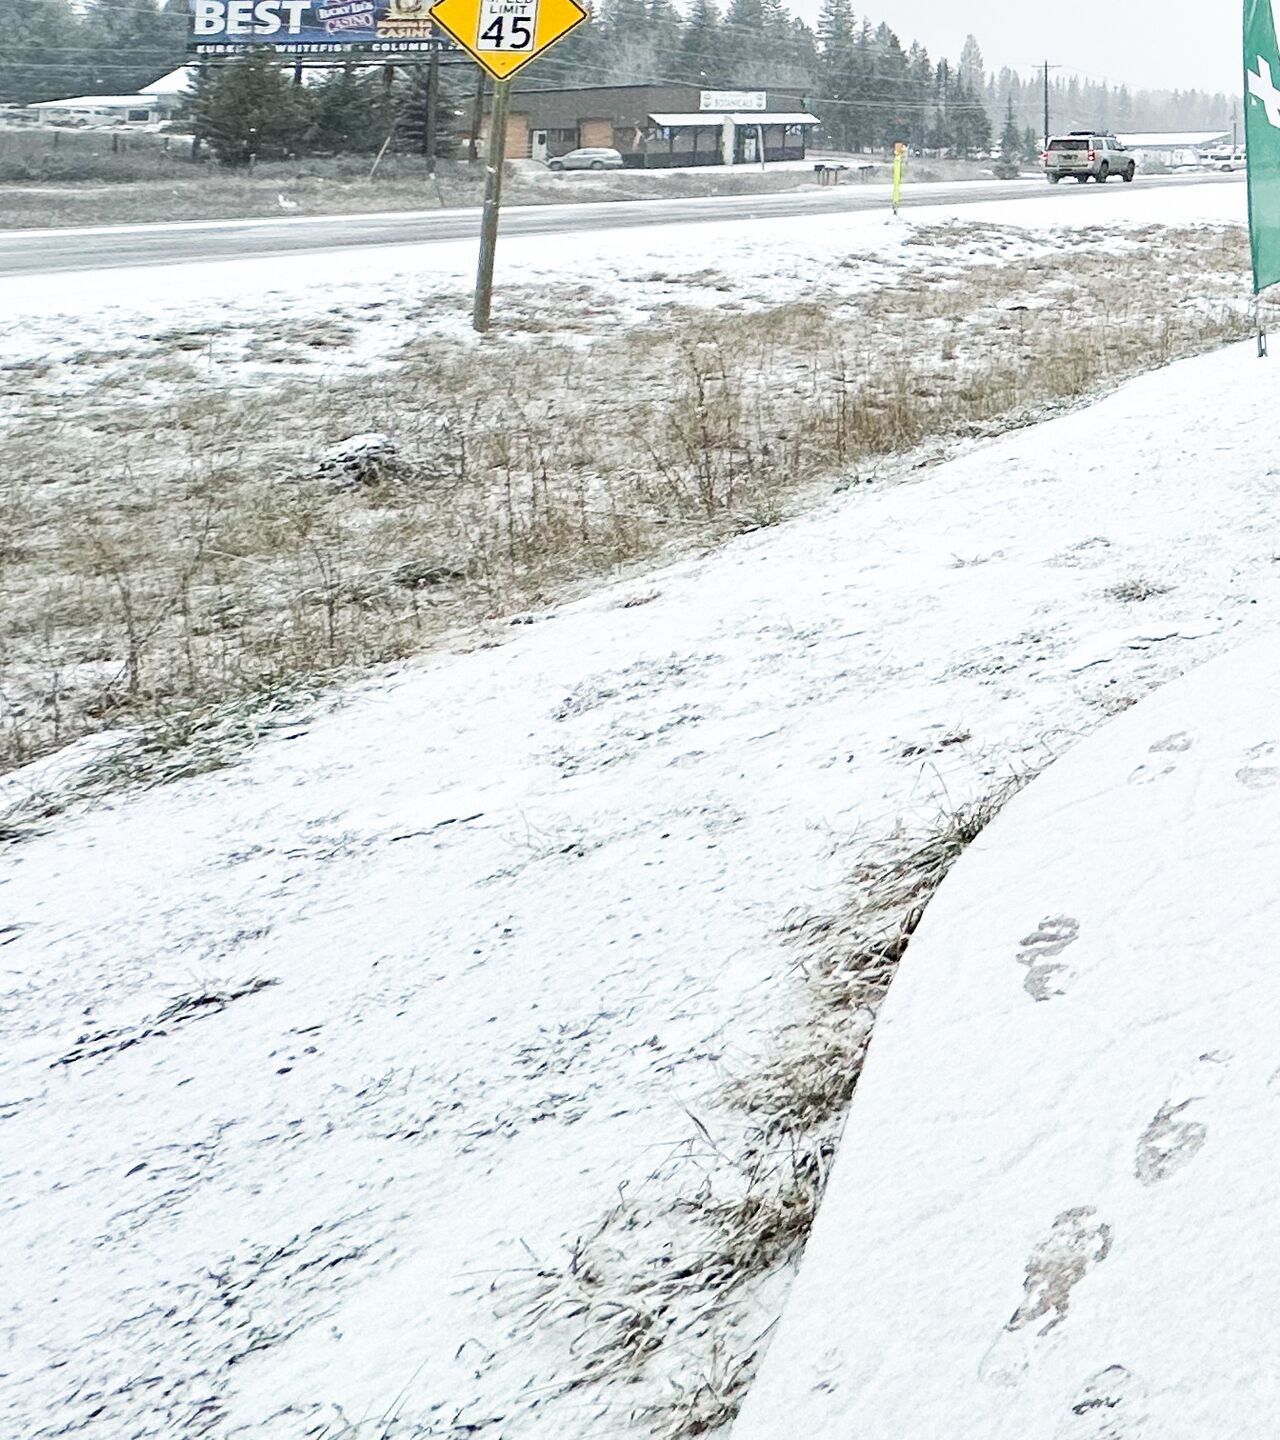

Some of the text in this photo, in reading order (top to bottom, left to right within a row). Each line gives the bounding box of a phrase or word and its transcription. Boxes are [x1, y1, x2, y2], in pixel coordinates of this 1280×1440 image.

[193, 0, 312, 35] BEST
[490, 5, 528, 15] LIMIT
[325, 13, 374, 33] CASINO
[480, 15, 532, 49] 45
[196, 44, 255, 53] EURE
[275, 43, 352, 53] WHITEFISH
